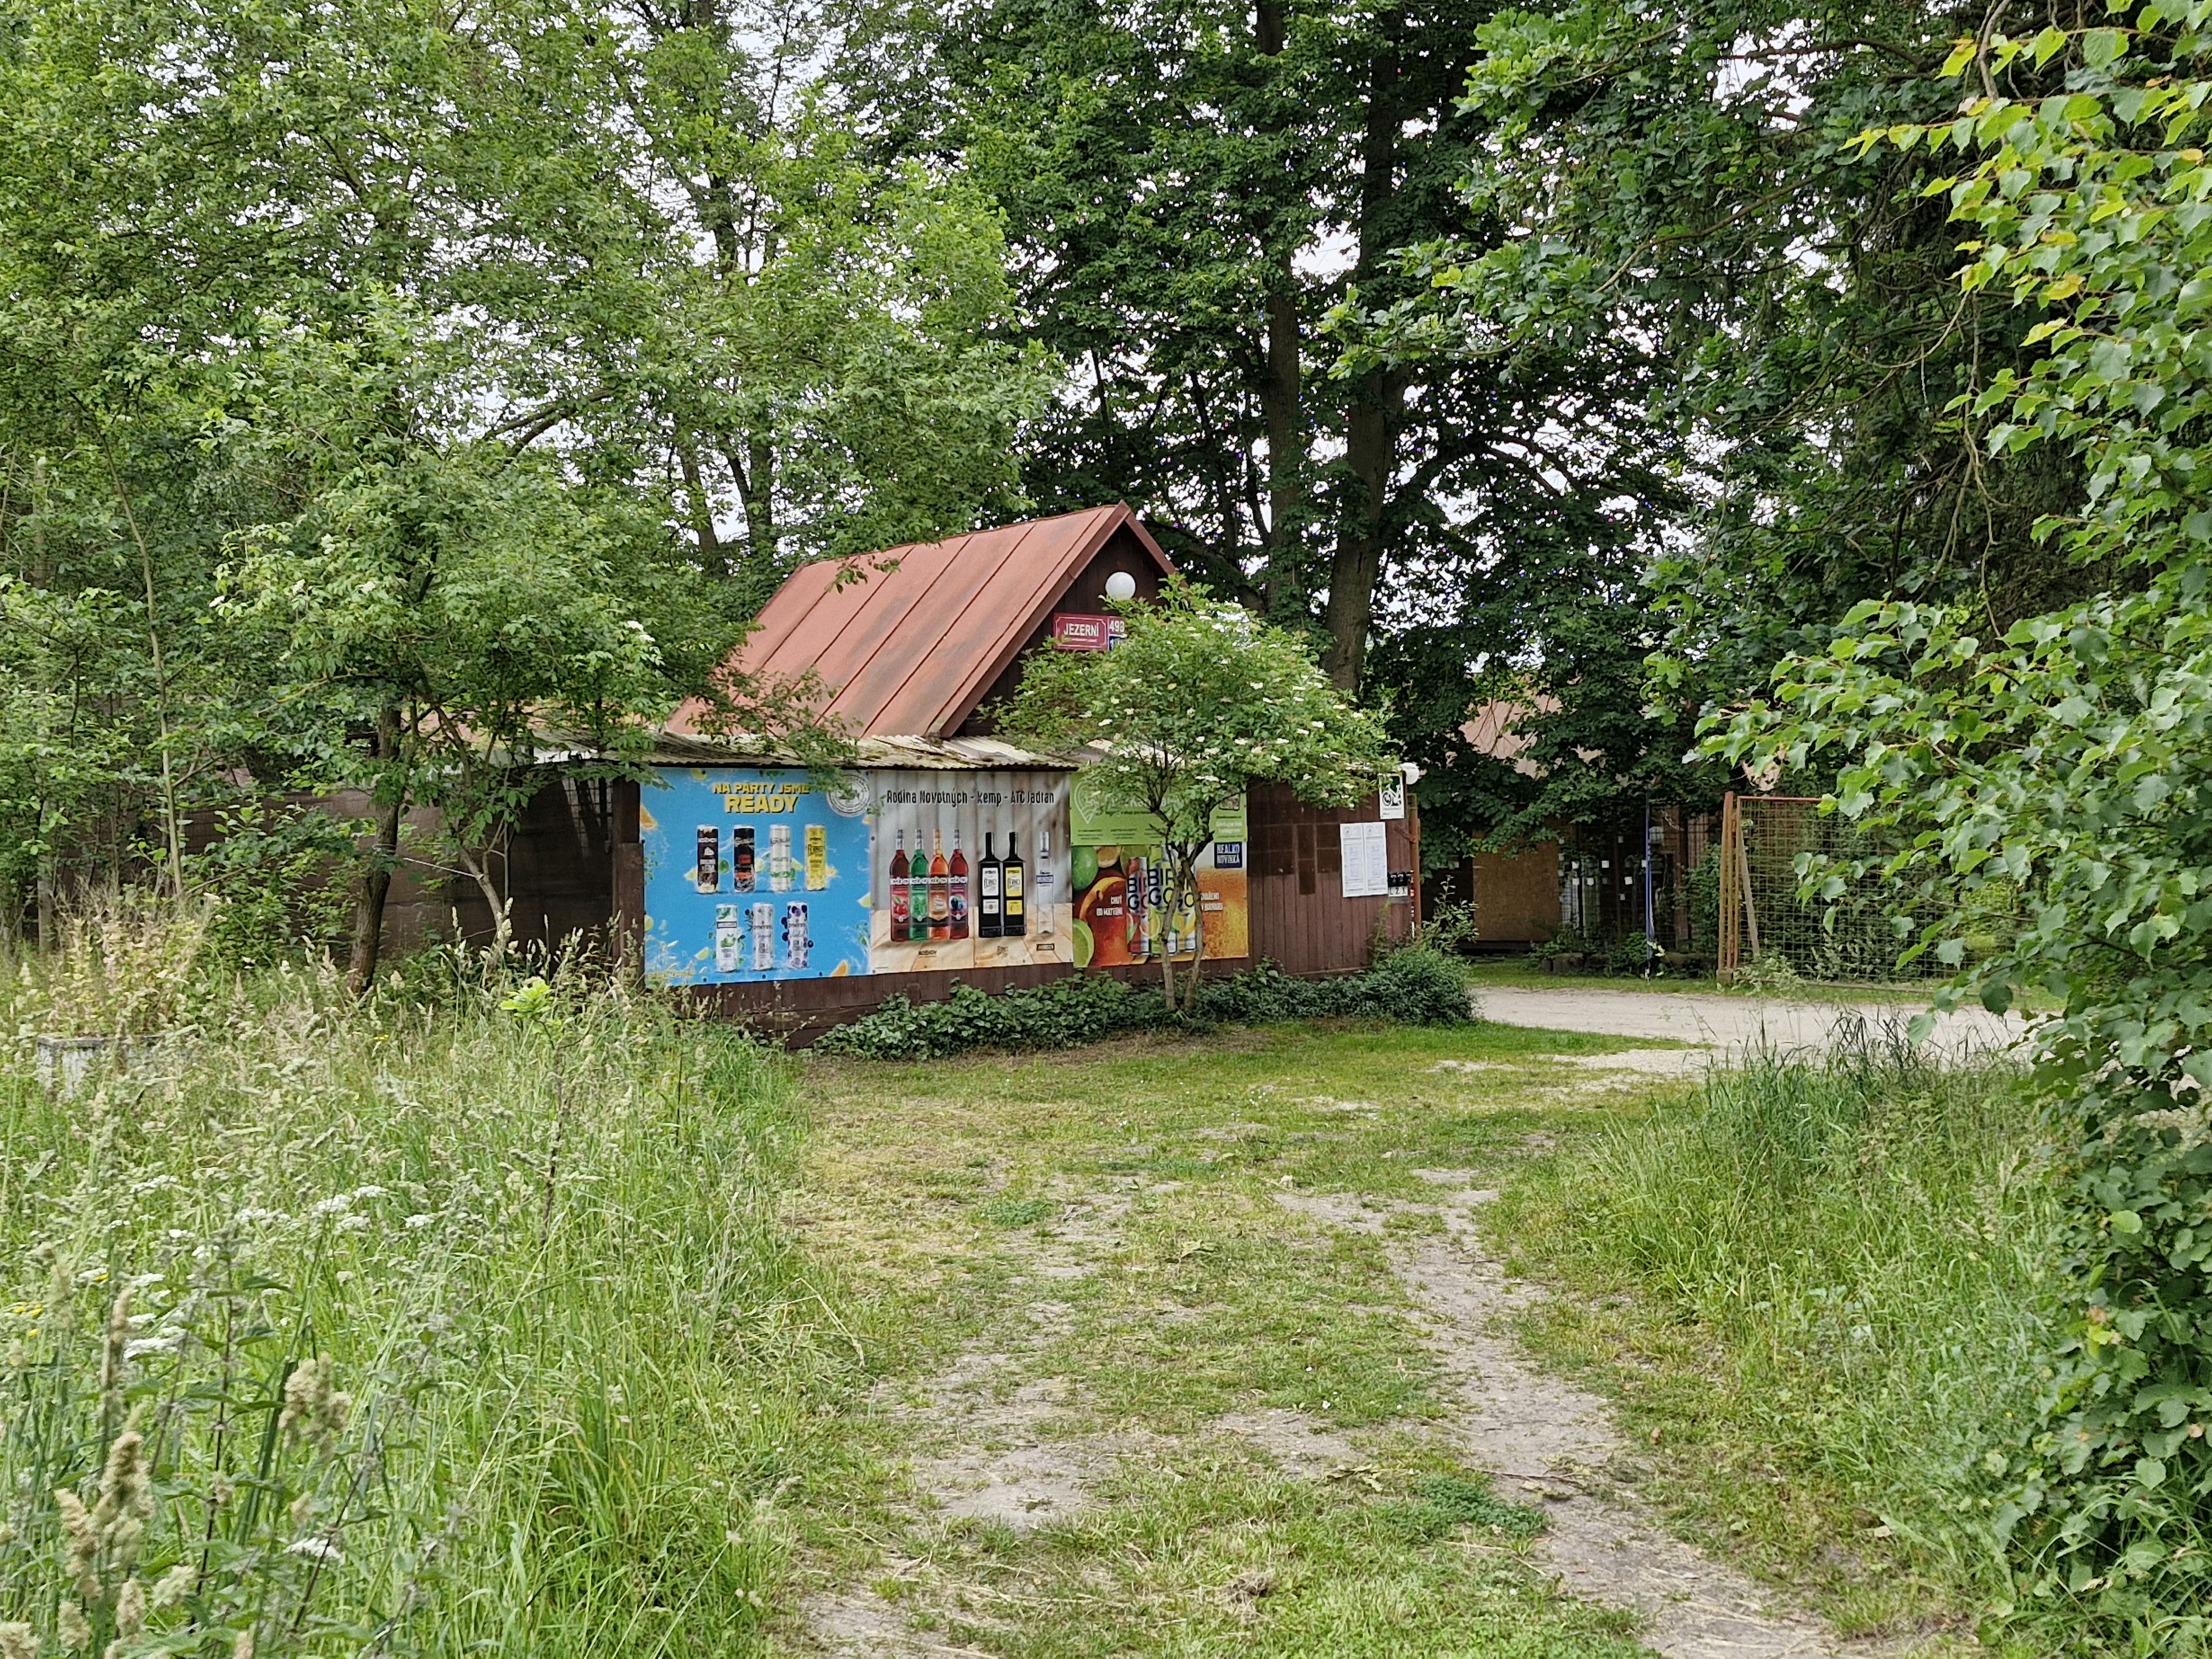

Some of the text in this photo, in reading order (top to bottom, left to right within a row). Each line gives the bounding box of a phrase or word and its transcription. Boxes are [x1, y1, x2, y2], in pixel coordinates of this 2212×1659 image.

[1063, 622, 1099, 637] JEZERNÍ
[713, 782, 732, 794] NA
[726, 795, 798, 813] READY
[887, 789, 917, 804] Rodina
[920, 787, 968, 808] Novotných
[1011, 791, 1025, 804] ATC
[1027, 791, 1055, 804] Jadran
